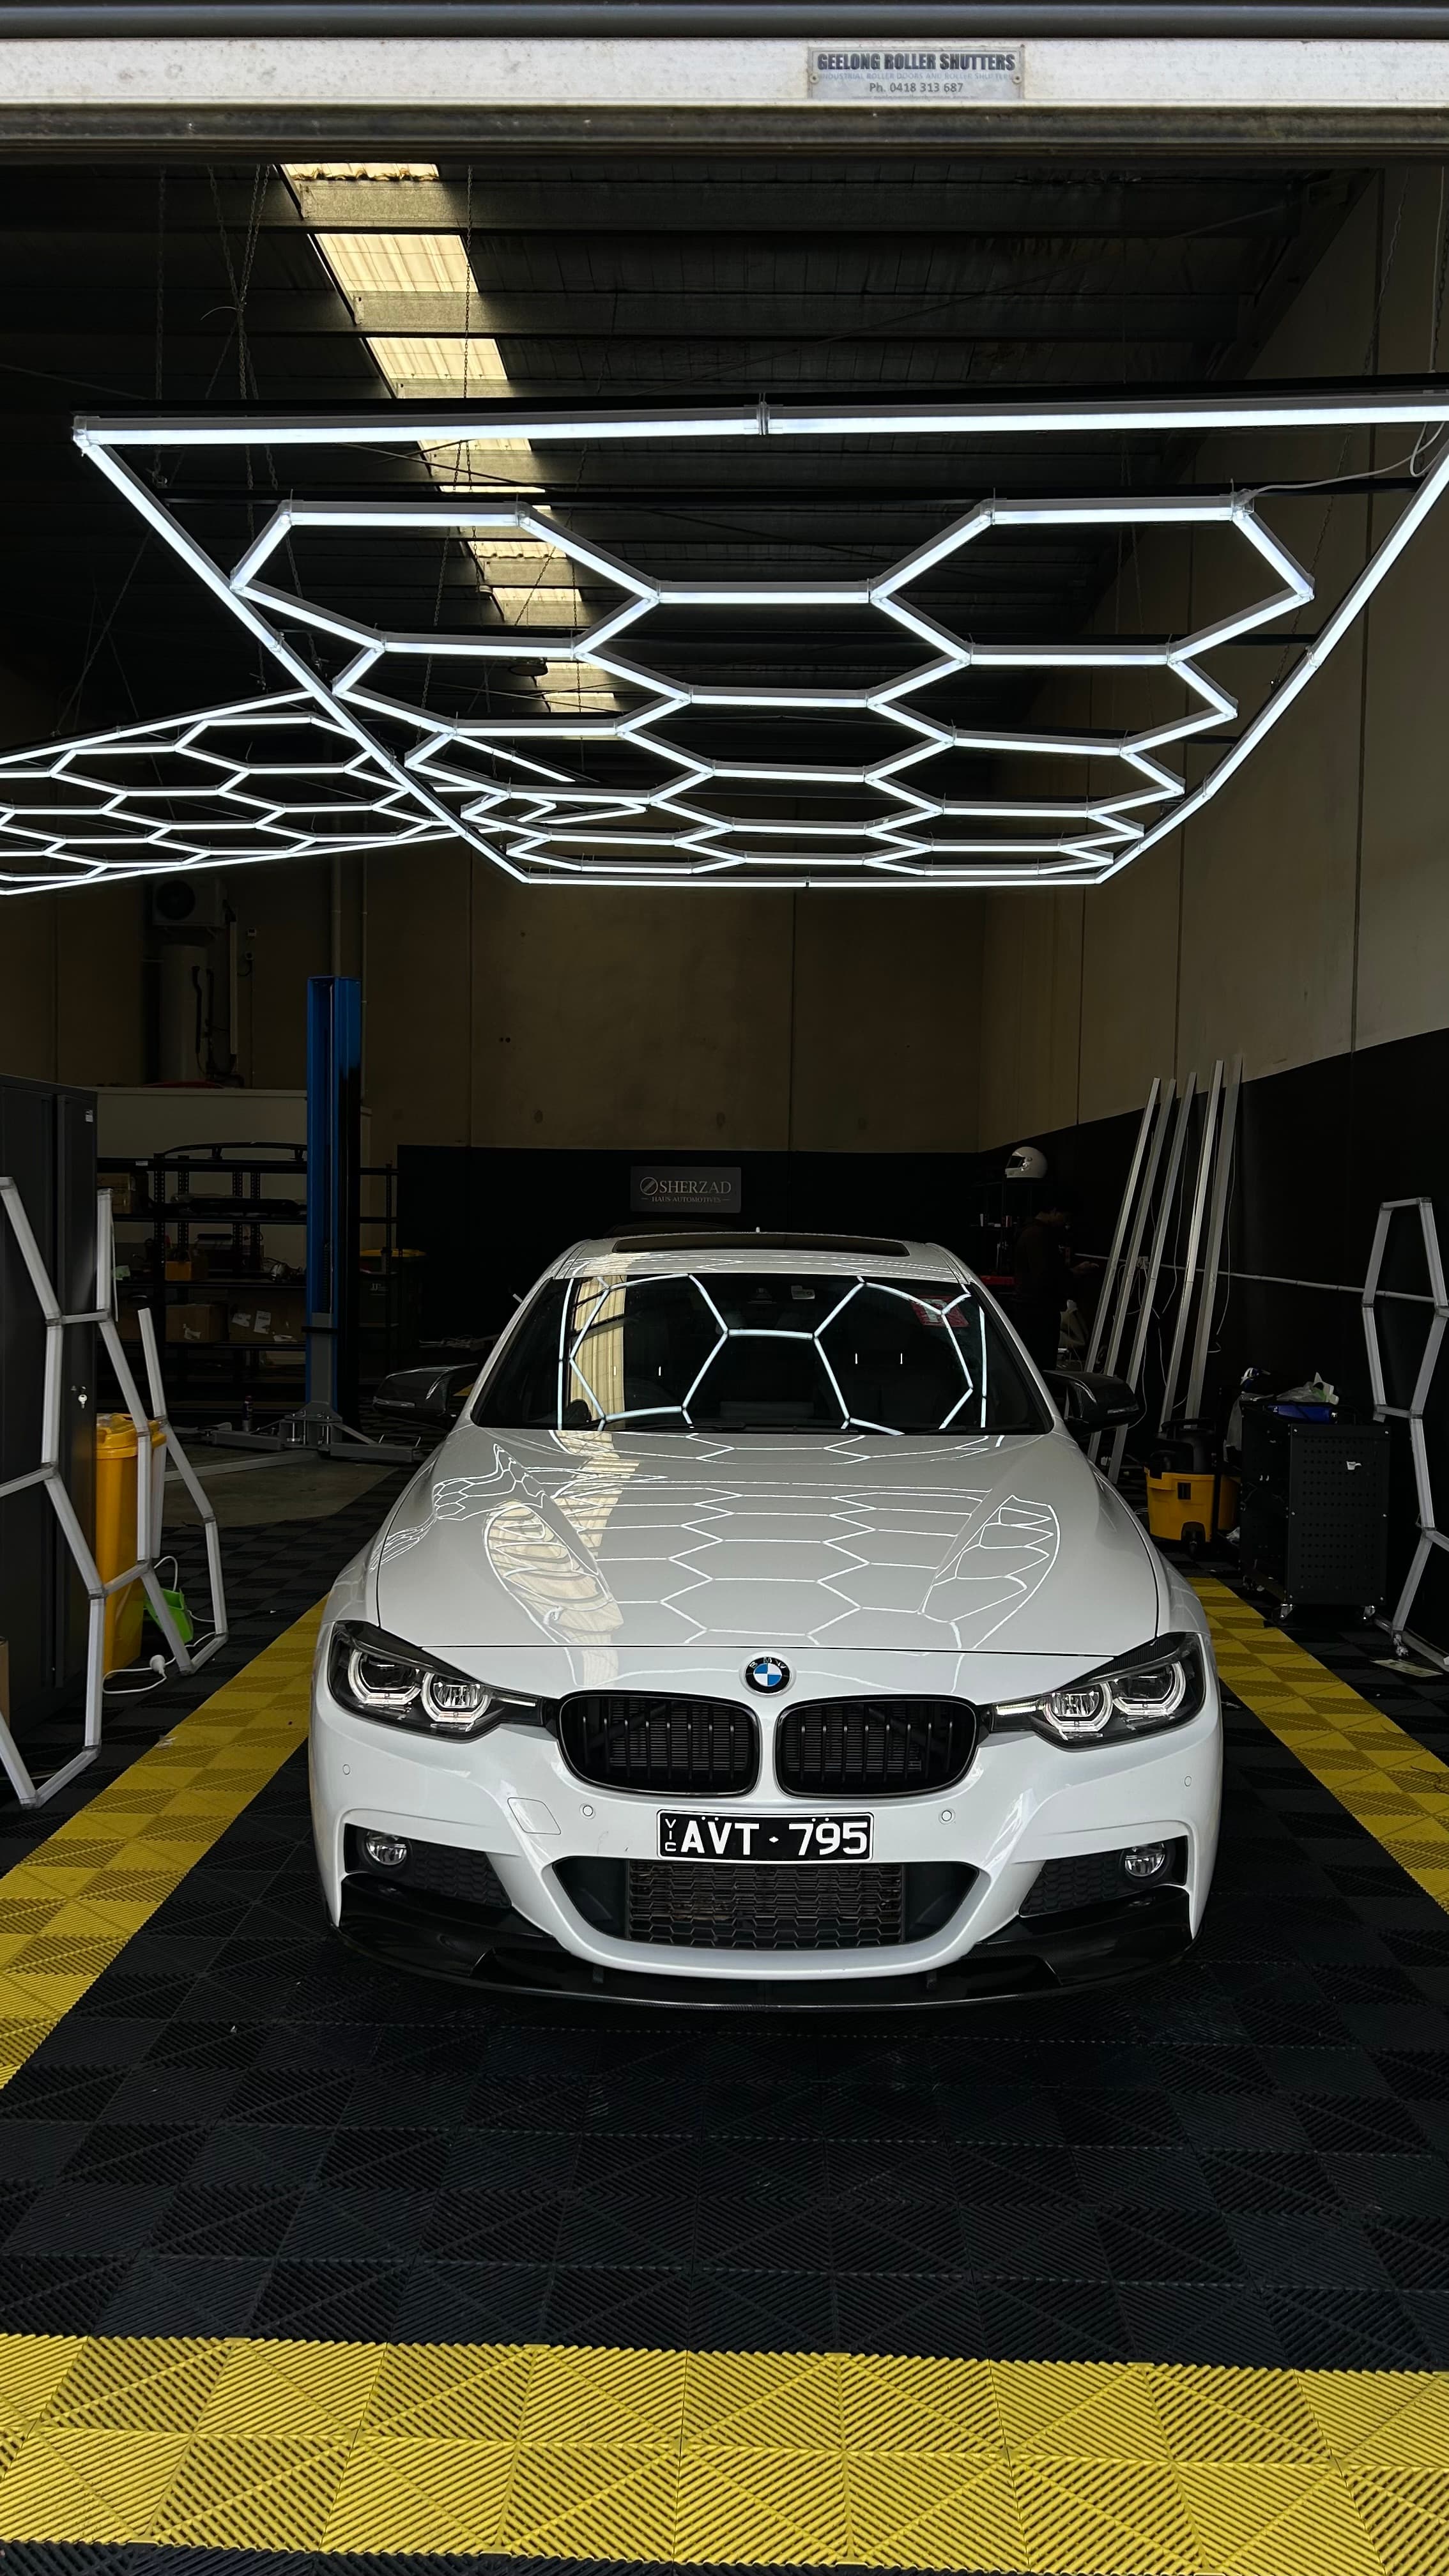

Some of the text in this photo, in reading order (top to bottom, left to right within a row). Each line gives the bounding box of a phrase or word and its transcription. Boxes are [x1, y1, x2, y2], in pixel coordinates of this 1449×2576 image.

[817, 53, 1015, 71] GEELONG ROLLER SHUTTERS
[870, 82, 963, 93] Ph. 0418 313 687
[659, 1180, 732, 1194] SHERZAD
[749, 1656, 787, 1669] BMW
[664, 1818, 677, 1851] VIC
[680, 1820, 868, 1856] AVT 795
